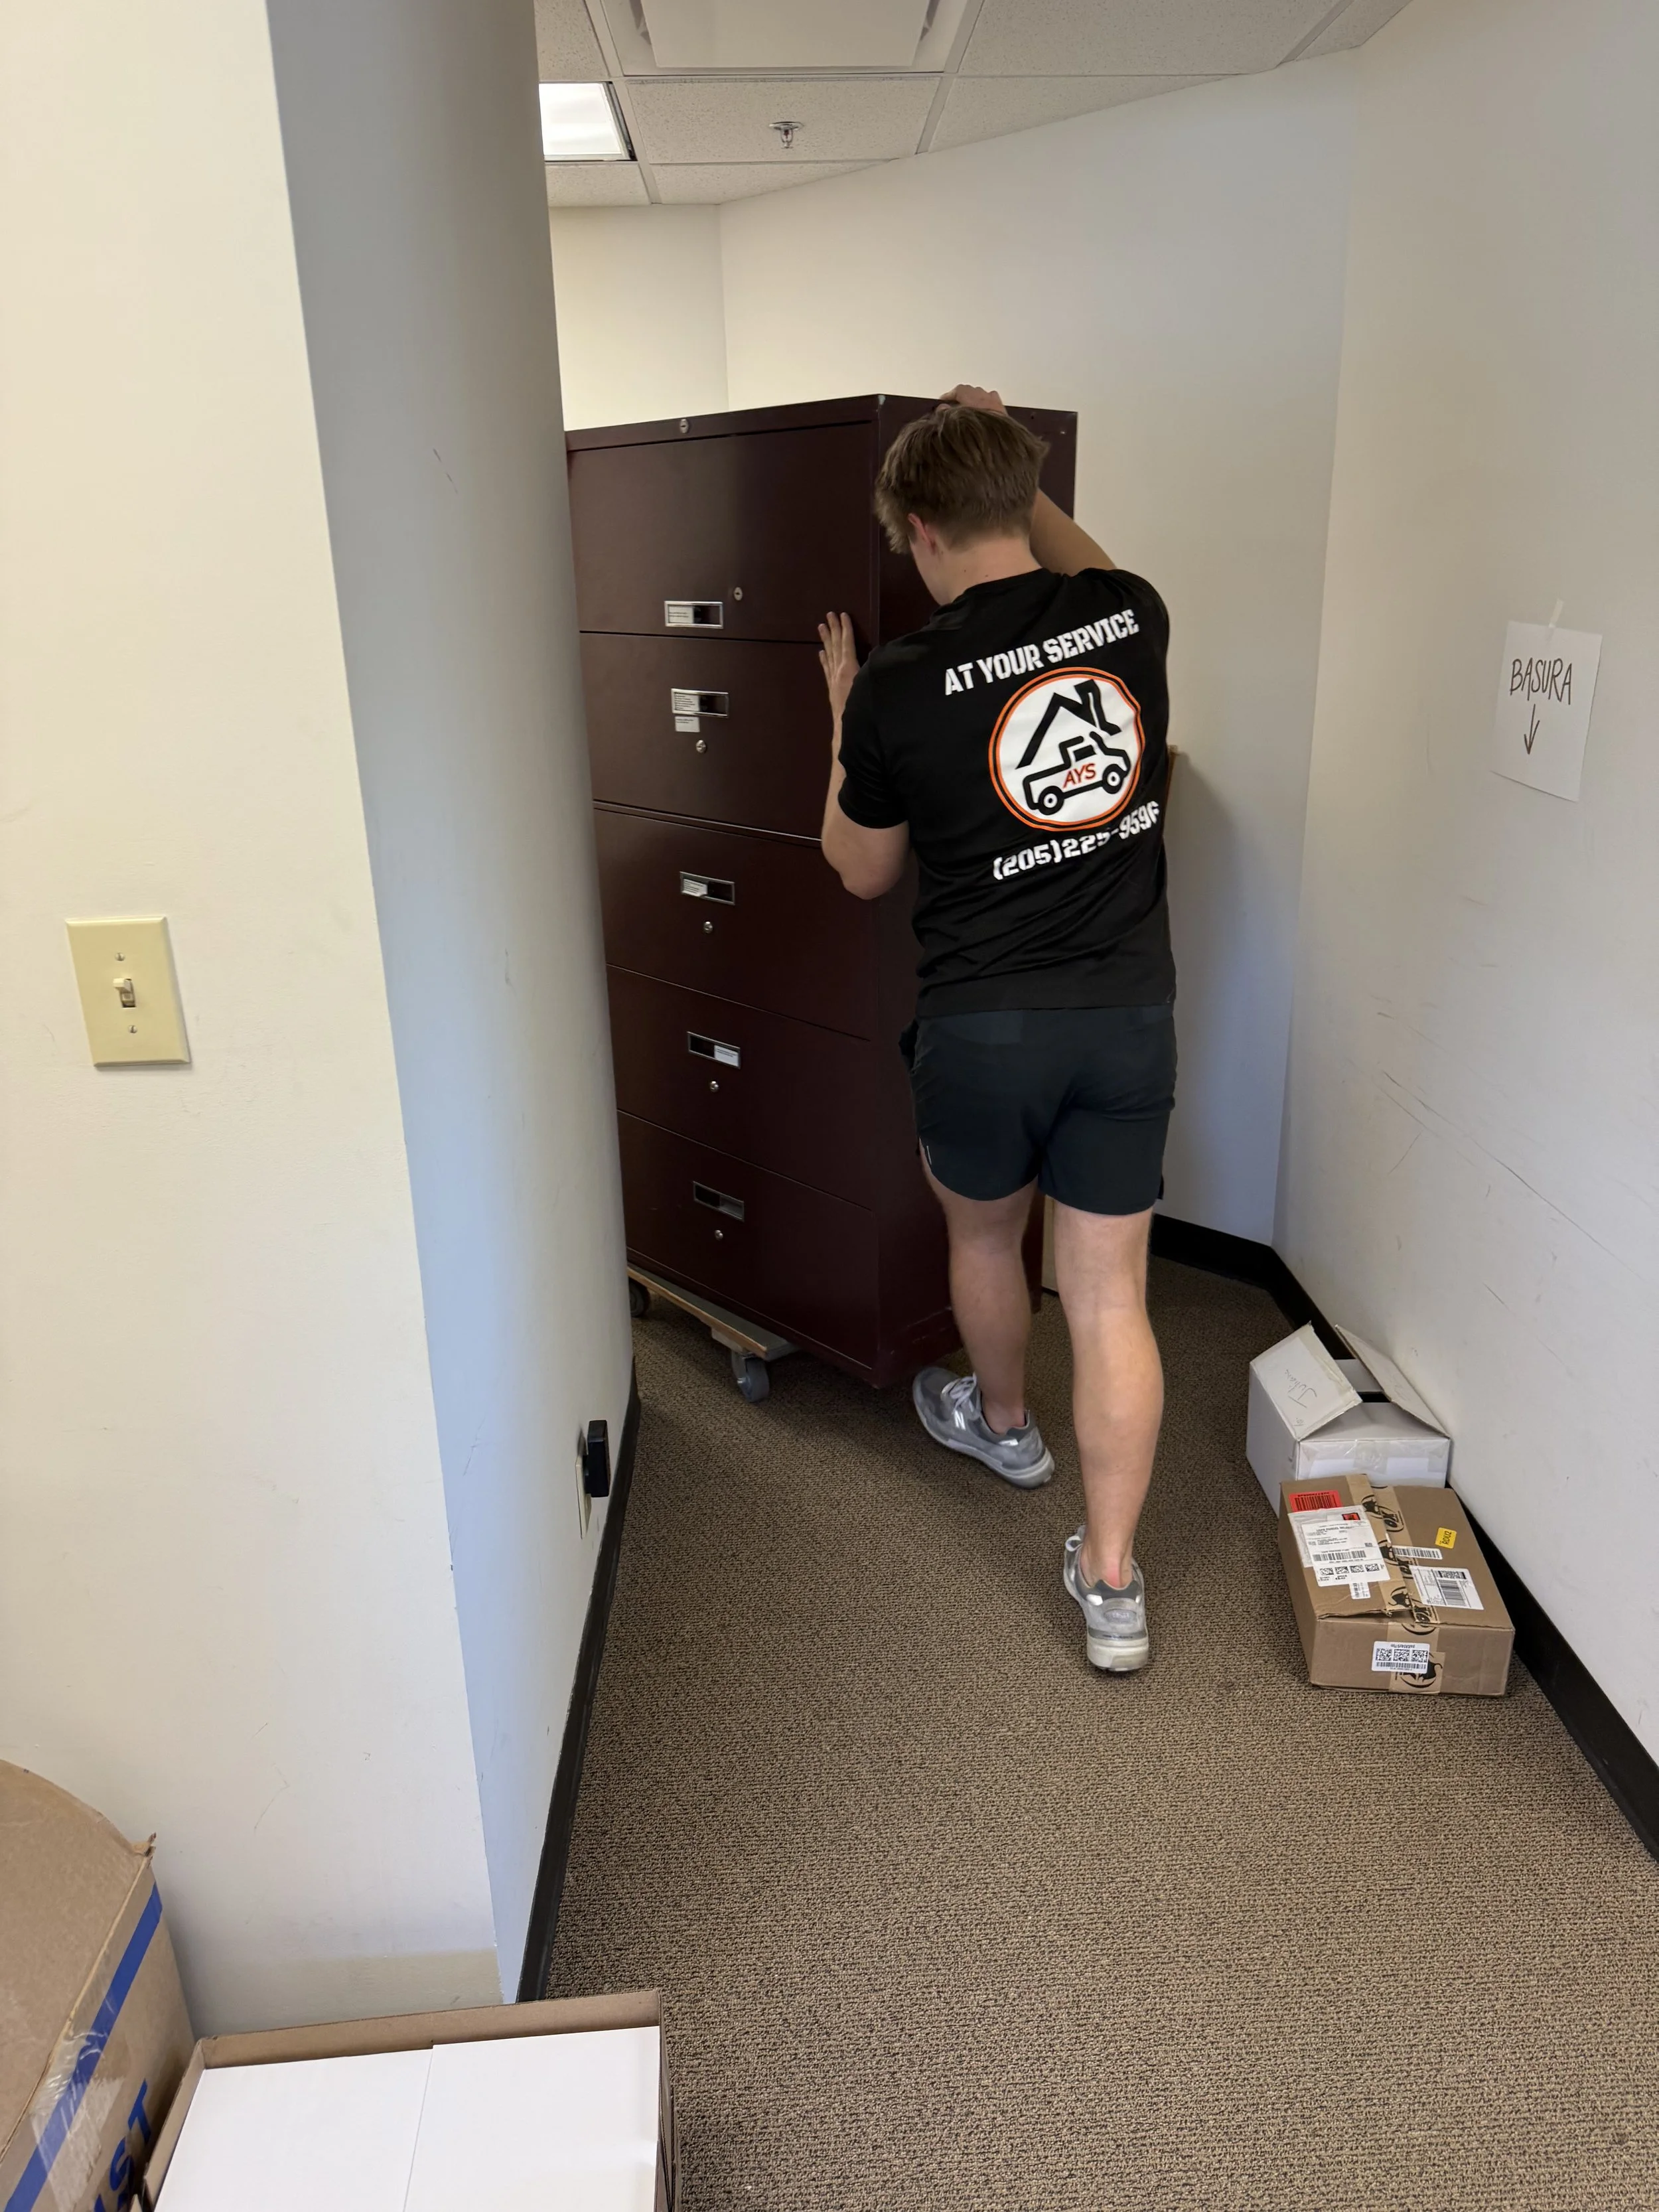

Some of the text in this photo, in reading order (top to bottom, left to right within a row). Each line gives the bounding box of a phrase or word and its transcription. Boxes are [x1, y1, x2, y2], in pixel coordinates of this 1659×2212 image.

[945, 609, 1139, 696] AT YOUR SERVICE
[1510, 657, 1573, 705] BASURA
[1062, 763, 1096, 788] AYS
[94, 2077, 152, 2212] ST
